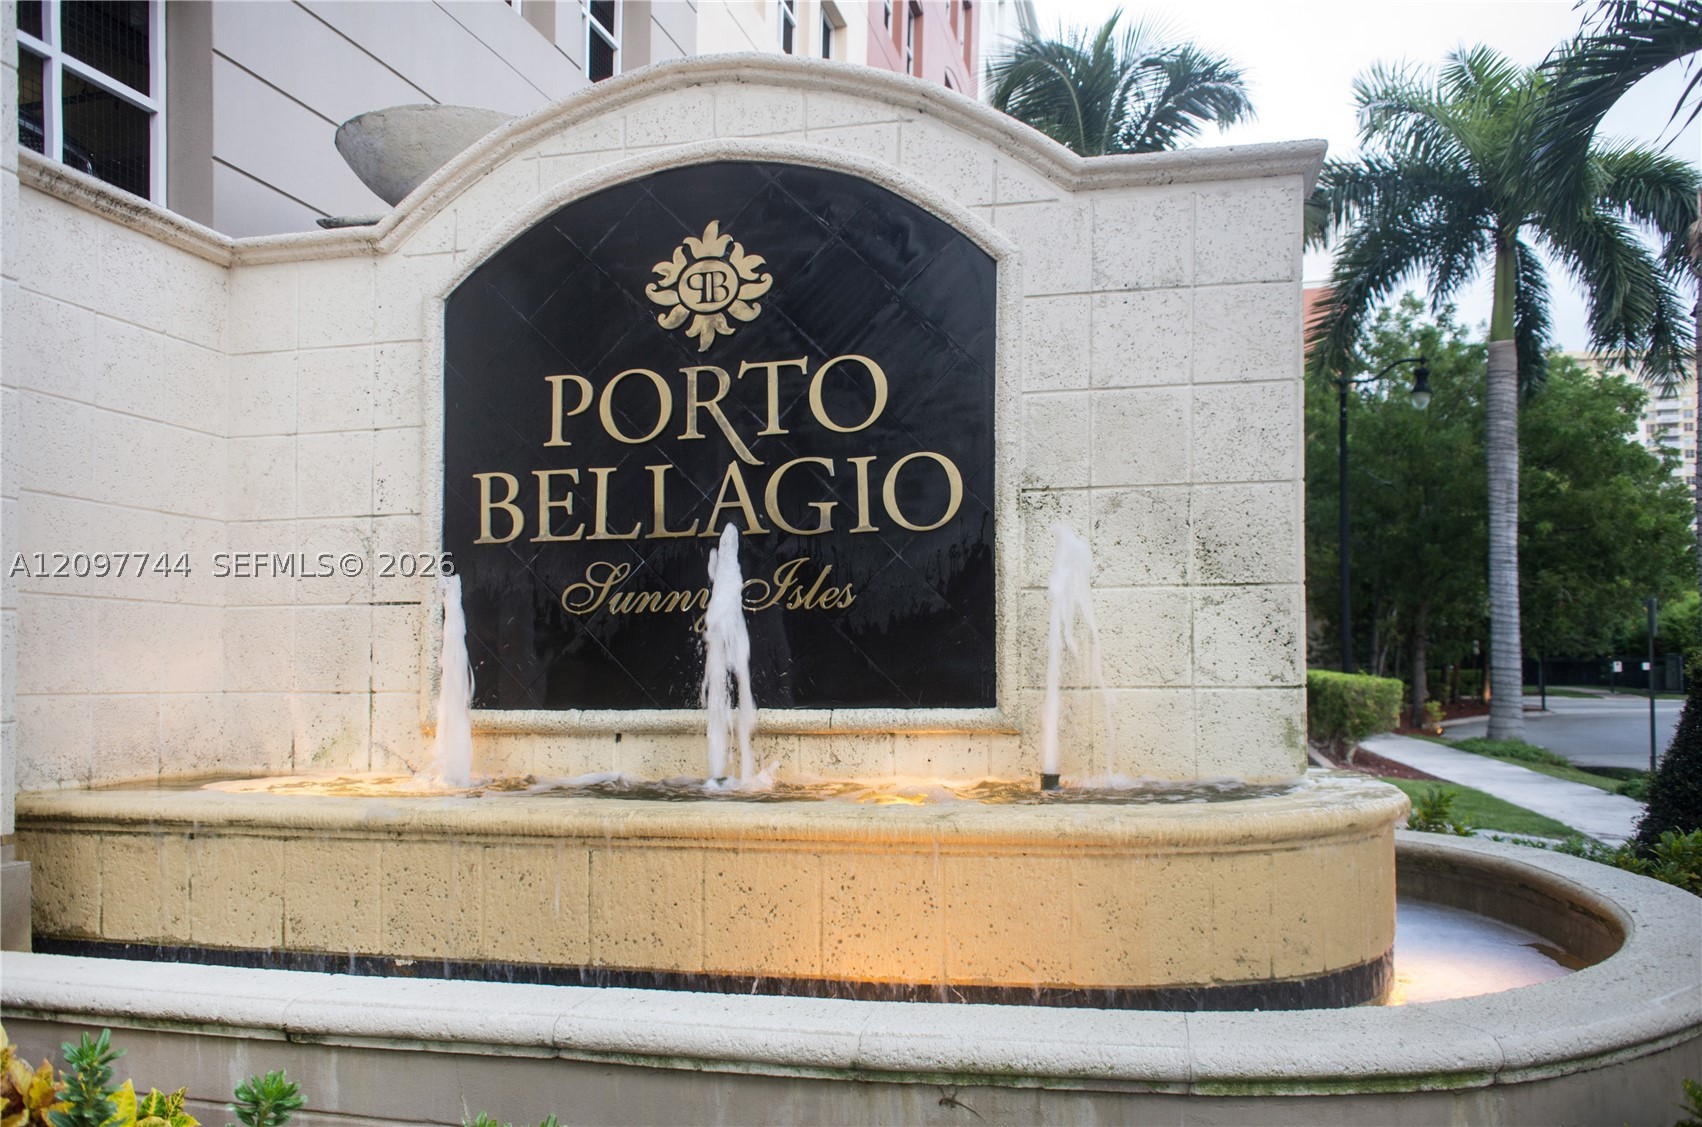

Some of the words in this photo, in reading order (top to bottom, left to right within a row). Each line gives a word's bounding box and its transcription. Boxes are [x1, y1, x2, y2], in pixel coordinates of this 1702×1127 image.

[542, 354, 889, 466] PORTO
[472, 451, 964, 545] BELLAGIO
[741, 557, 857, 611] Isles
